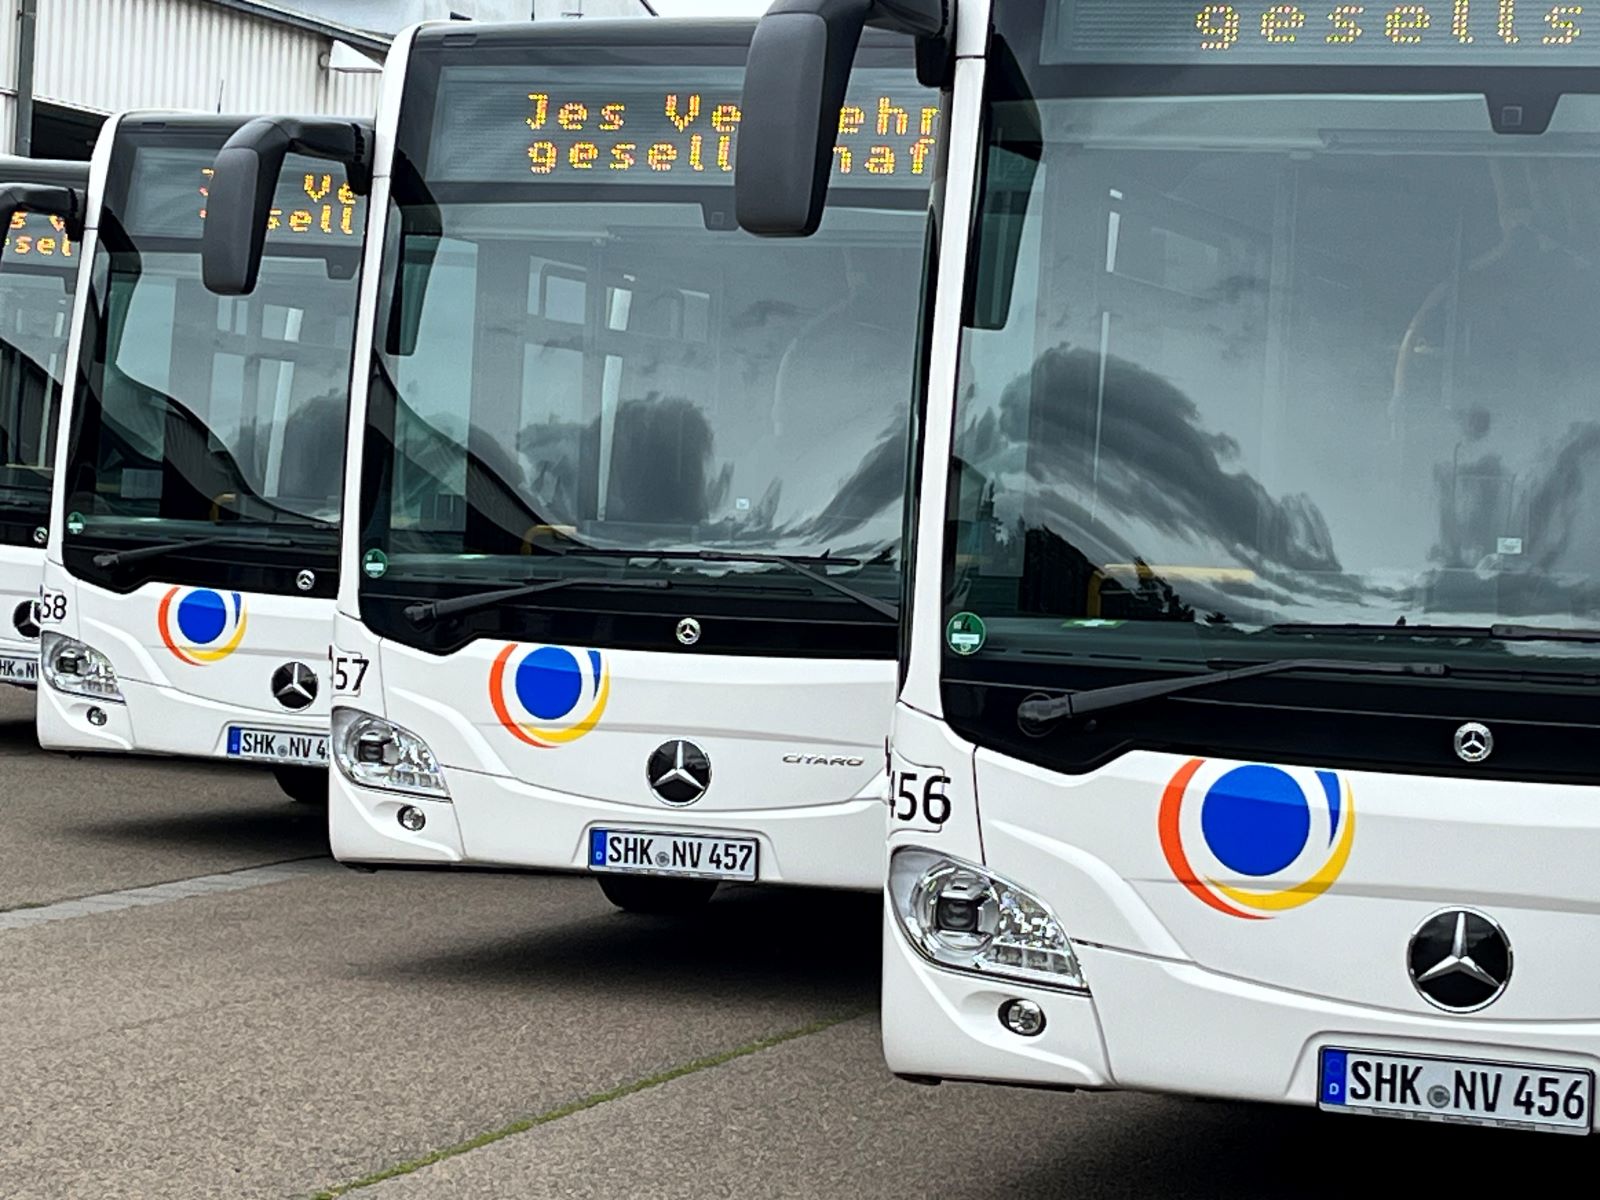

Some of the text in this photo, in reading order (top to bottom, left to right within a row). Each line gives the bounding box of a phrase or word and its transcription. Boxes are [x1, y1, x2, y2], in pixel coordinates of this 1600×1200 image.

[1196, 0, 1583, 49] gesells
[525, 93, 625, 130] Jes
[331, 656, 370, 691] 57
[242, 732, 276, 755] SHK
[289, 736, 312, 758] NV
[782, 753, 865, 767] CITARO
[888, 770, 952, 825] 56
[608, 836, 653, 865] SHK
[672, 840, 702, 868] NV
[708, 843, 753, 871] 457
[1328, 1060, 1585, 1120] D SHK NV 456
